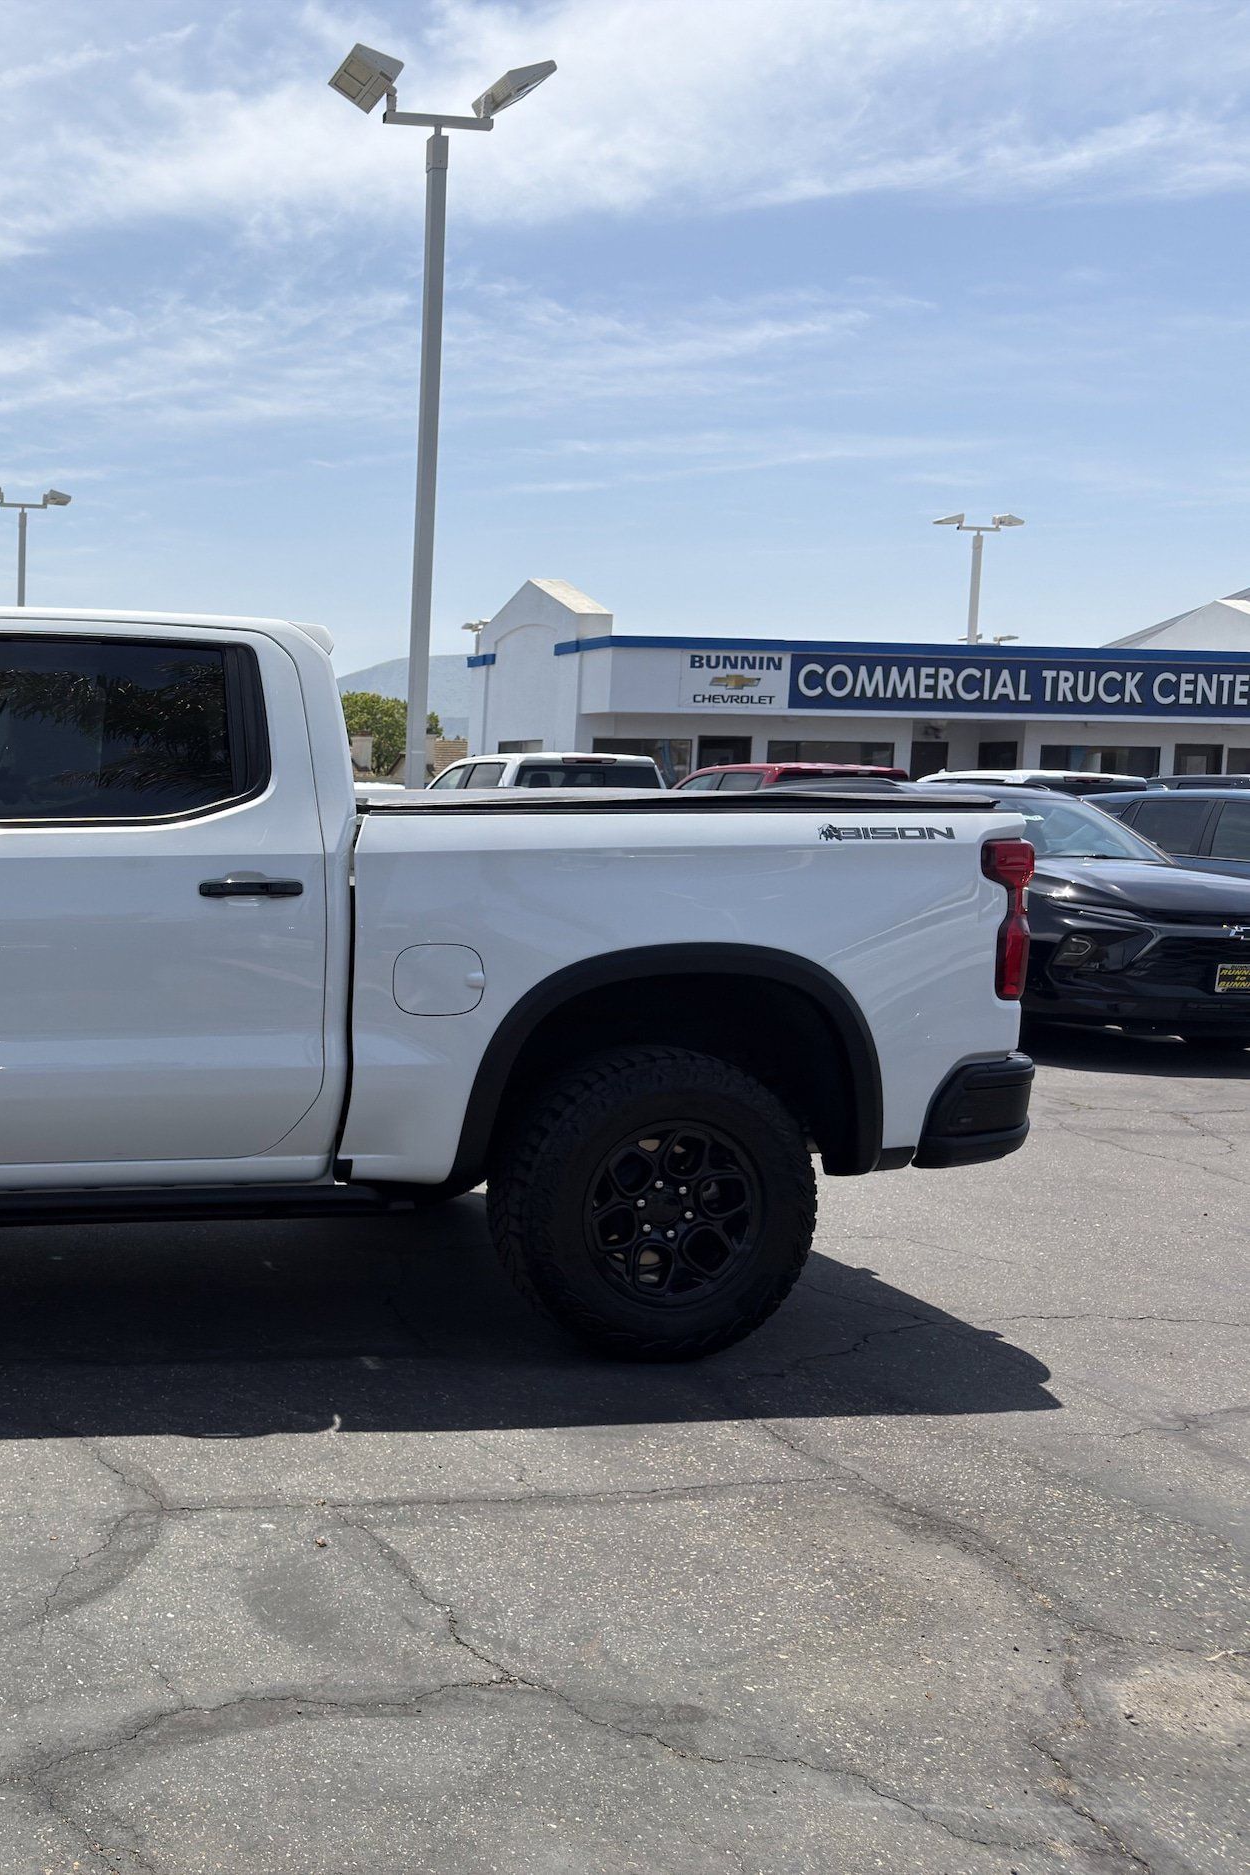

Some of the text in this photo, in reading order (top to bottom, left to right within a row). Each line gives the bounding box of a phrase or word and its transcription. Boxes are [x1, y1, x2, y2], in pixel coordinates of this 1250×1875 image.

[690, 654, 782, 671] BUNNIN
[797, 662, 1250, 706] COMMERCIAL TRUCK CENTE
[692, 693, 775, 705] CHEVROLET
[836, 827, 956, 840] BISON
